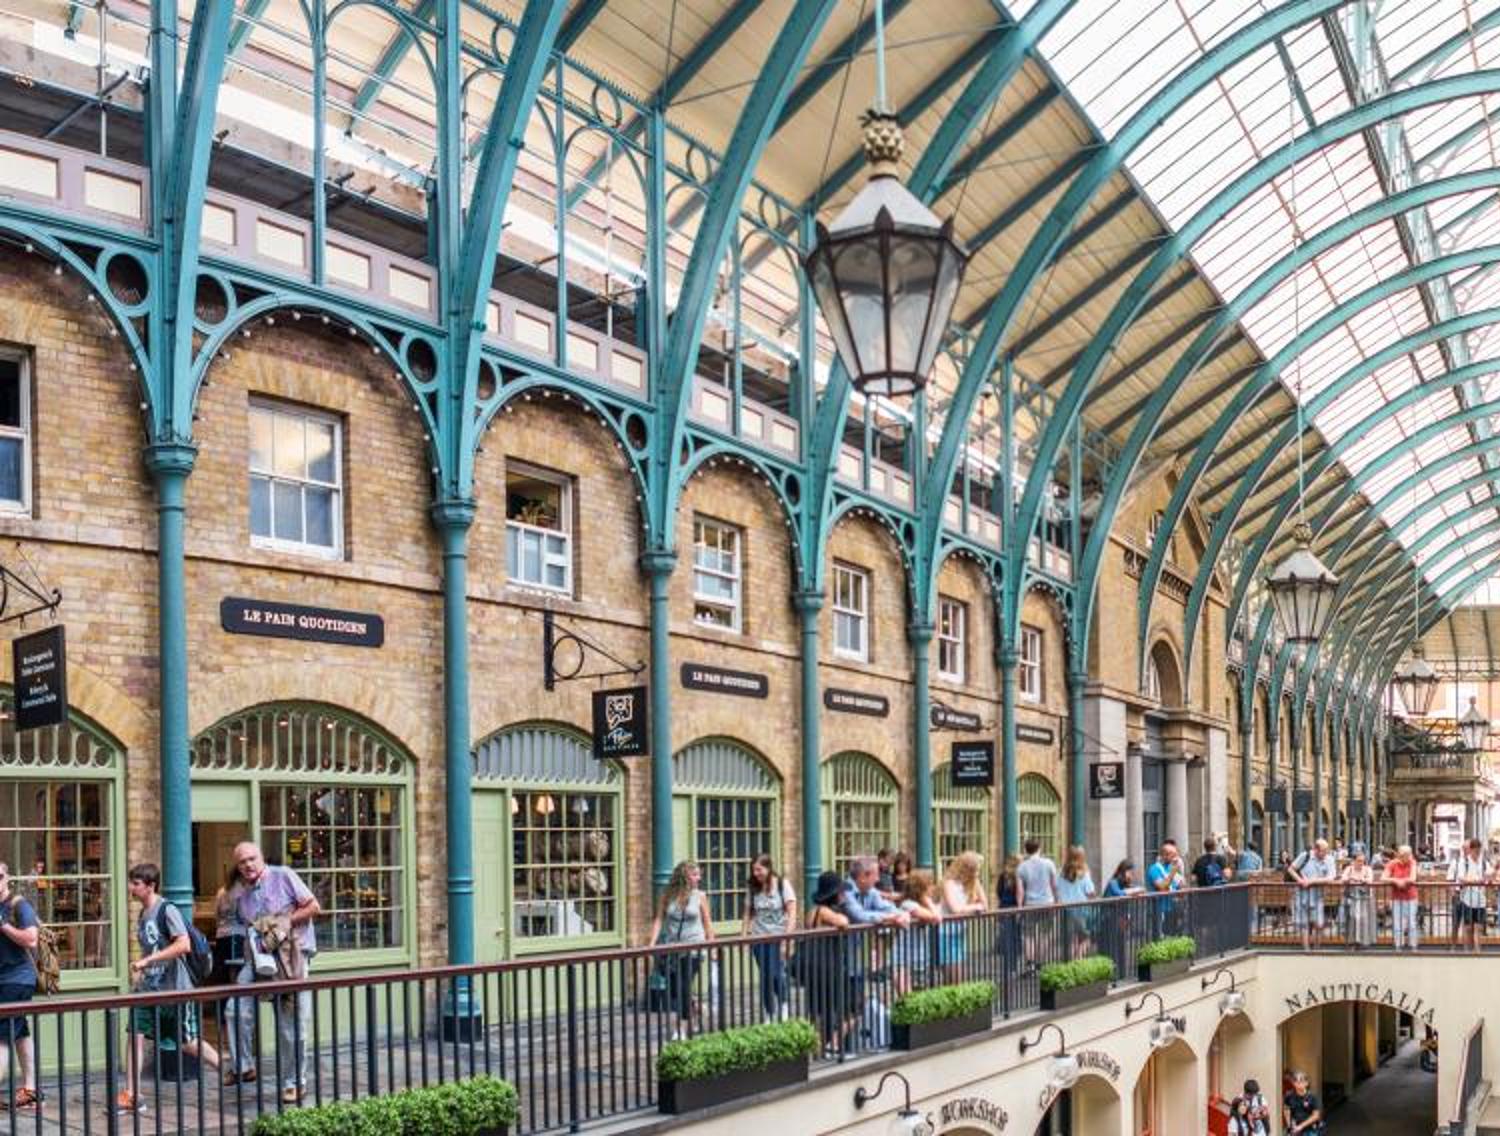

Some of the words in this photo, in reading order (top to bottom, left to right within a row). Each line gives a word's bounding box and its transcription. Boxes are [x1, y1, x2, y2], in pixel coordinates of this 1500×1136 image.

[243, 609, 261, 623] LE
[265, 612, 296, 627] PAIN
[299, 615, 367, 635] QUOTIDIEN
[1284, 984, 1435, 1024] NAUTICALIA
